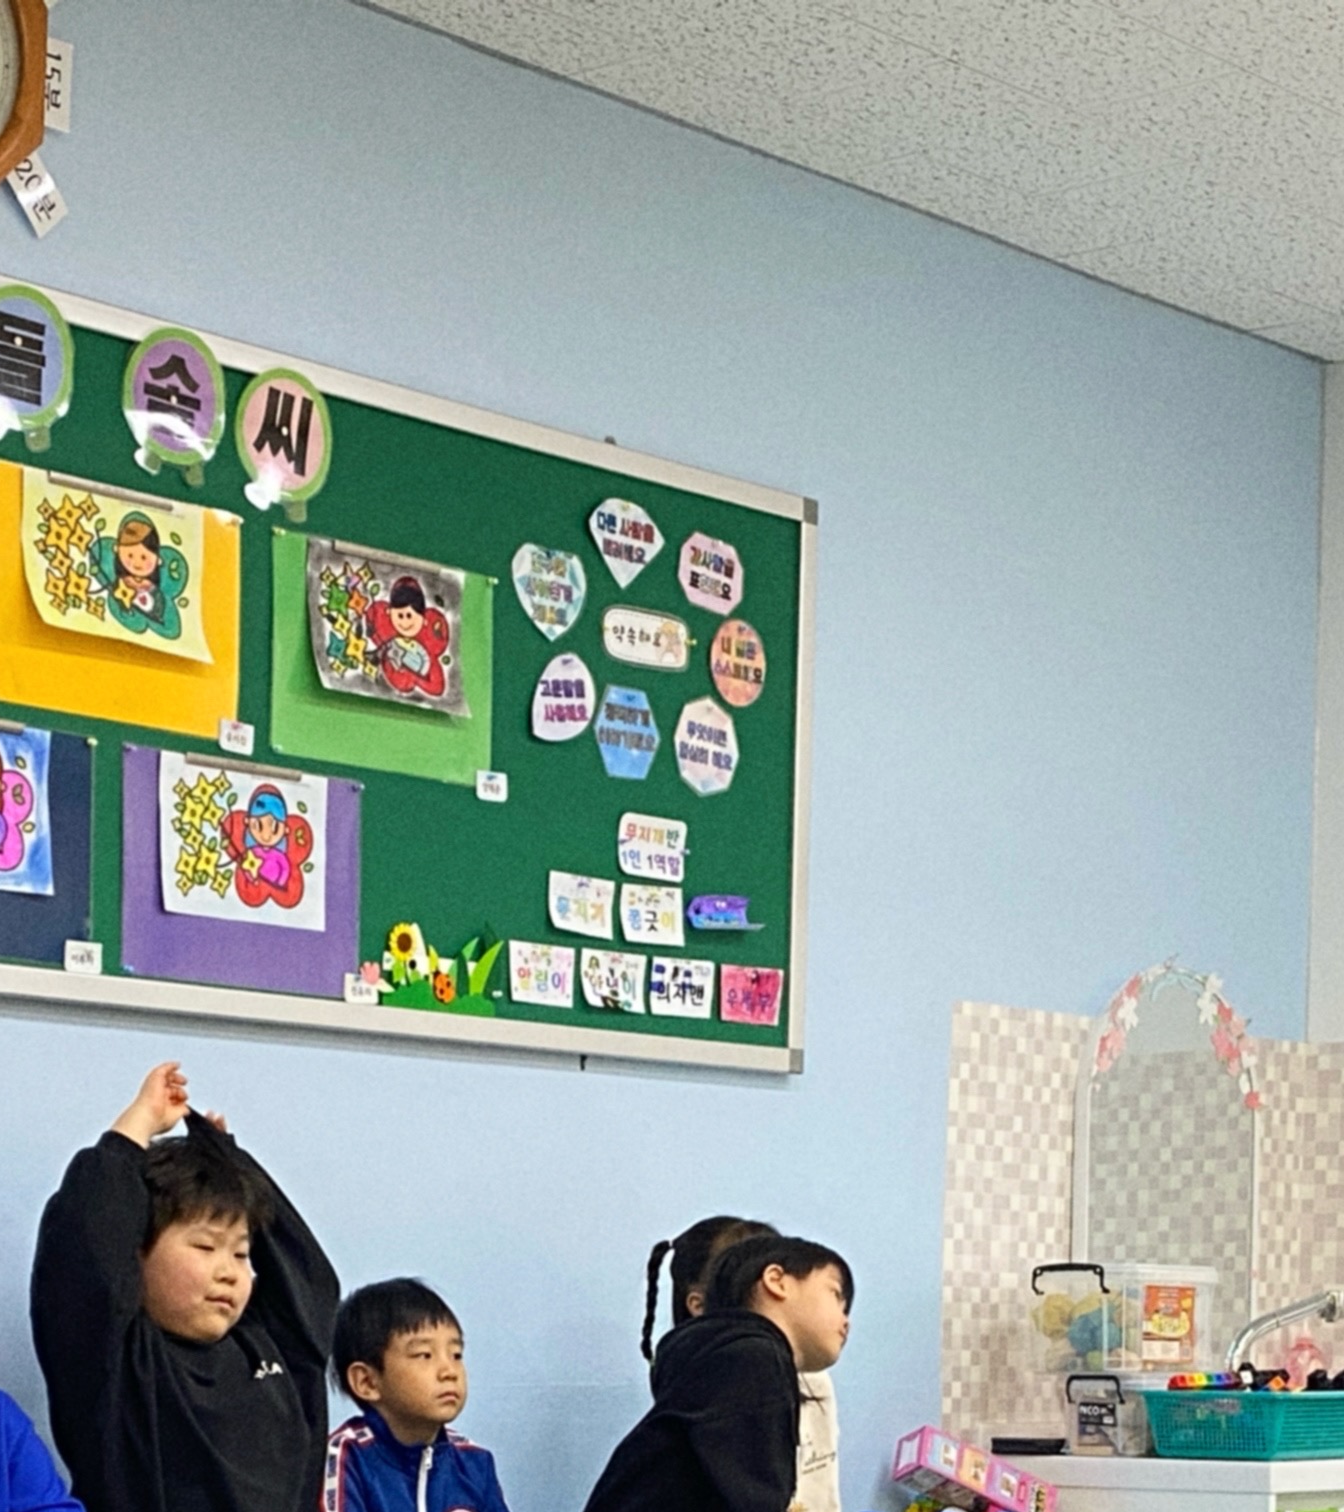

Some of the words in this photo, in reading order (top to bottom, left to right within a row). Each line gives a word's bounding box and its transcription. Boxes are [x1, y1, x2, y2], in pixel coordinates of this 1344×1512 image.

[14, 157, 57, 223] 20분
[625, 822, 681, 850] 무지개반
[621, 849, 642, 871] 1인
[646, 853, 681, 877] 1역할
[657, 980, 706, 1008] 의자맨
